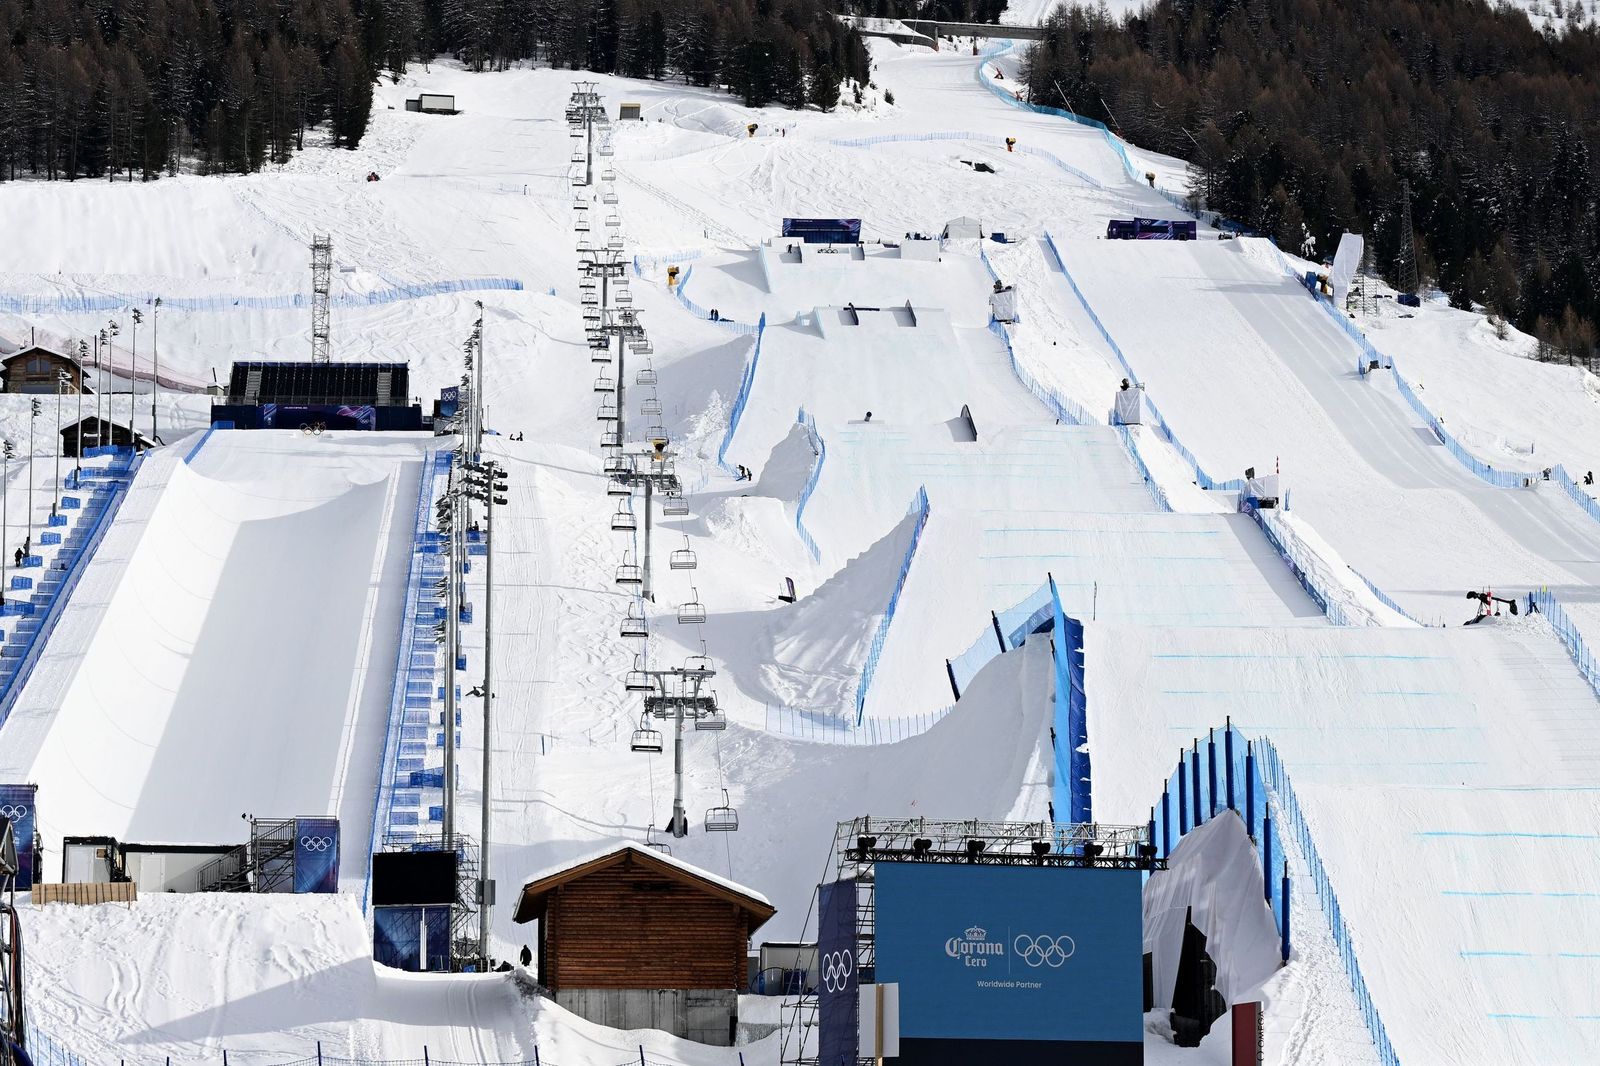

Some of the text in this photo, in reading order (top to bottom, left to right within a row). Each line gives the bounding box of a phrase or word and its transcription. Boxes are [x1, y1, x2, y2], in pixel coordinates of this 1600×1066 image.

[945, 937, 1004, 958] Corona
[965, 956, 987, 967] Cero
[977, 980, 1042, 989] Worldwide Partner
